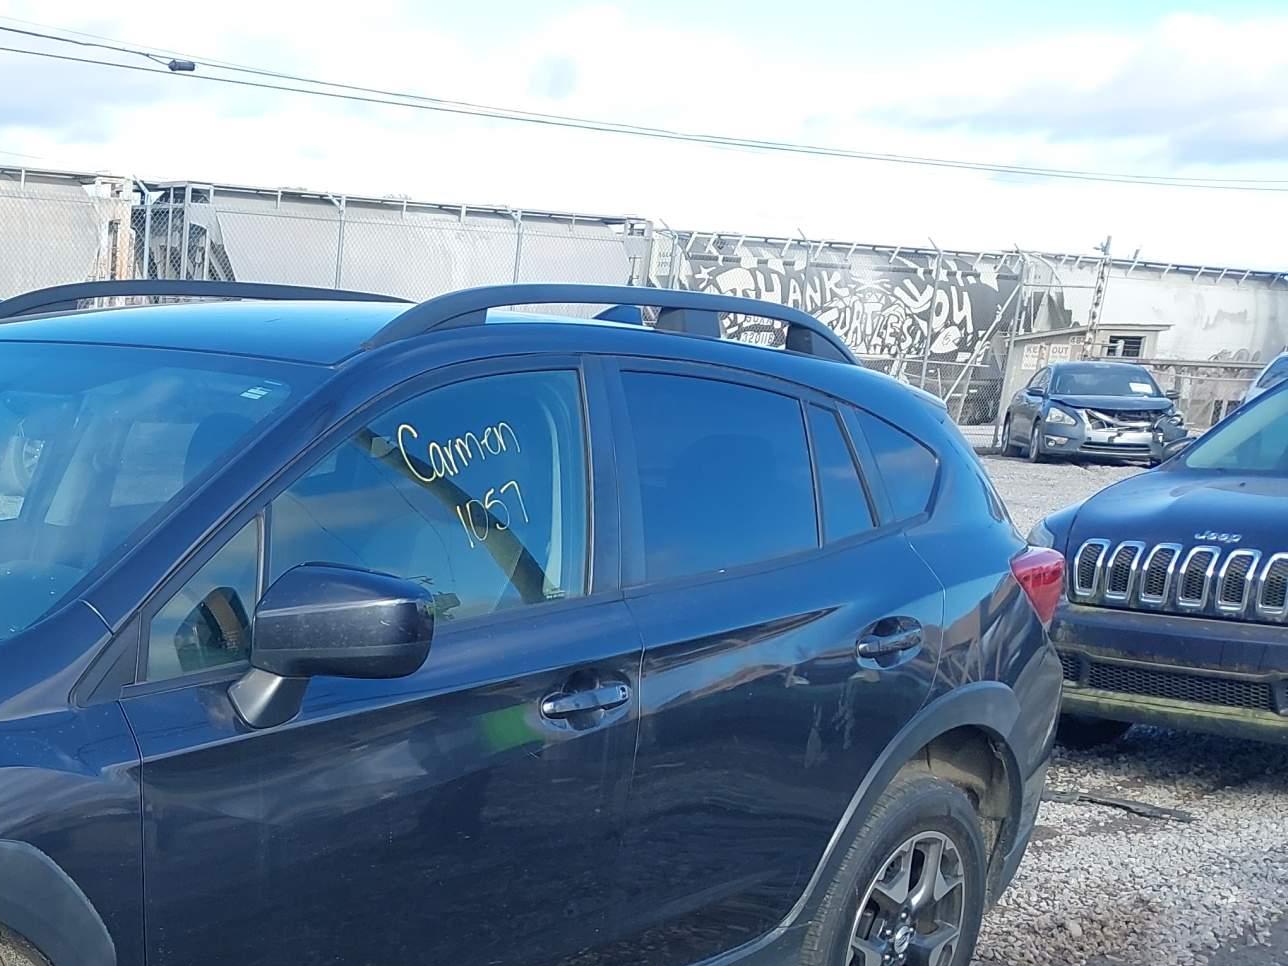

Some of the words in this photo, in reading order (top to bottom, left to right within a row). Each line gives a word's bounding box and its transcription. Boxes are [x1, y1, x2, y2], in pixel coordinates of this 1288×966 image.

[1052, 346, 1069, 354] OUT
[397, 422, 521, 482] Carmen
[456, 480, 529, 549] 1057
[1194, 530, 1242, 543] Jeep
